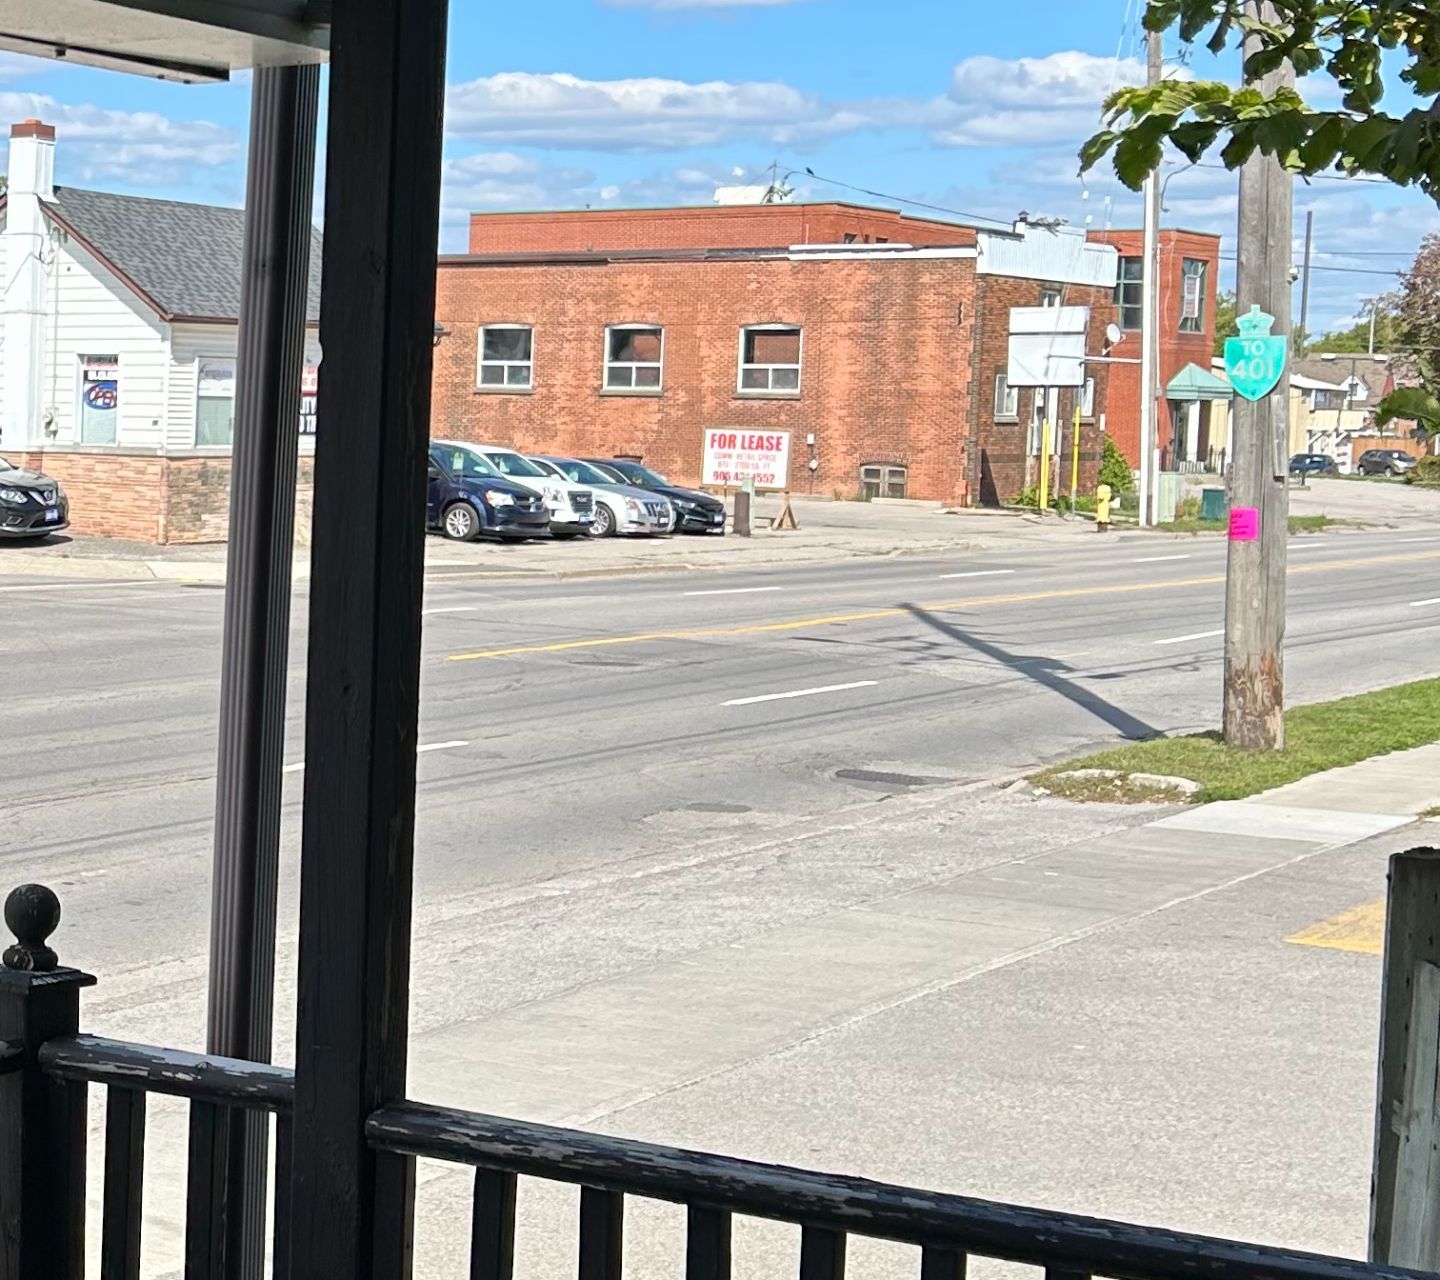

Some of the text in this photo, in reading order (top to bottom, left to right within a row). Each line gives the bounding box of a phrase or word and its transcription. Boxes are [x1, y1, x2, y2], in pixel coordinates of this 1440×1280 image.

[1240, 340, 1265, 356] TO
[1231, 358, 1274, 380] 401
[710, 433, 783, 451] FOR LEASE
